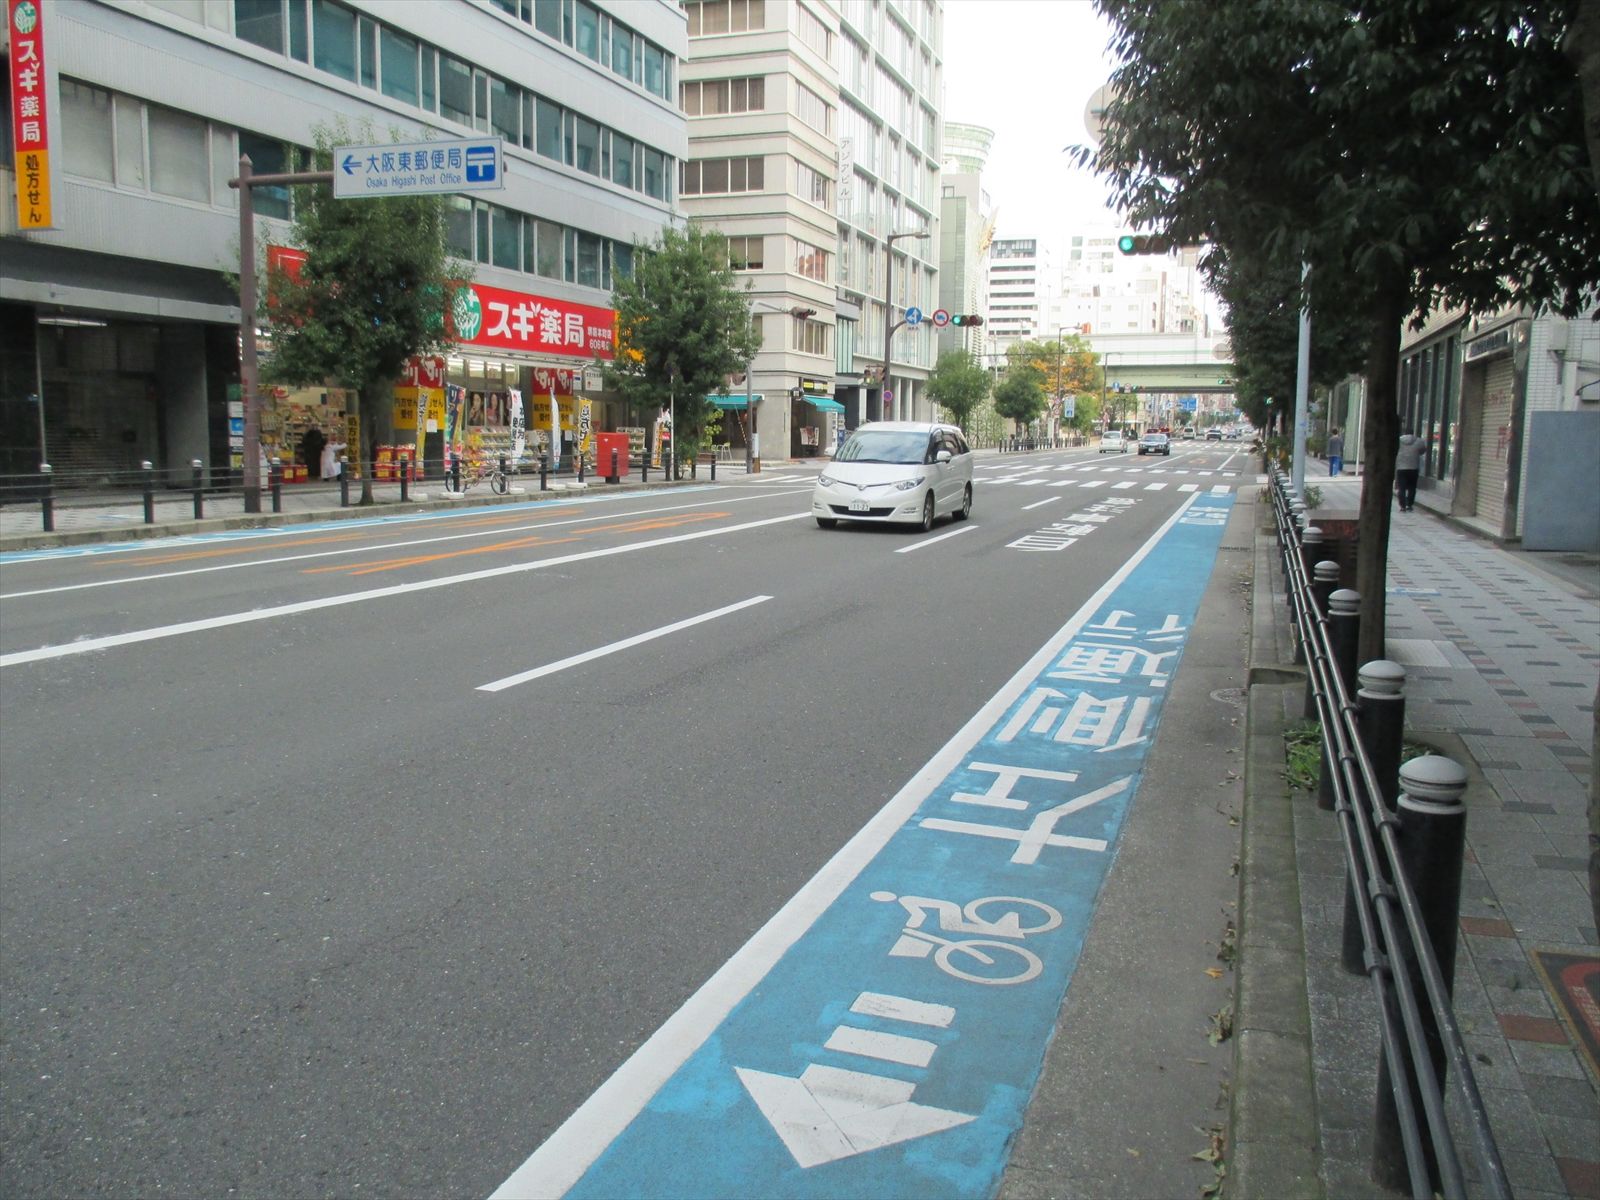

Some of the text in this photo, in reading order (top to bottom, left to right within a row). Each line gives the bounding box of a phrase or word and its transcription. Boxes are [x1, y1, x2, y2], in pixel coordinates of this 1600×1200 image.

[17, 39, 42, 144] スギ薬局
[26, 154, 42, 224] 処方せん
[365, 148, 462, 174] 大阪東郵便局
[366, 173, 462, 190] Osaka Higashi Post Office
[840, 140, 850, 196] アジアビル
[487, 301, 585, 348] スギ薬局
[919, 609, 1187, 866] 左側通行
